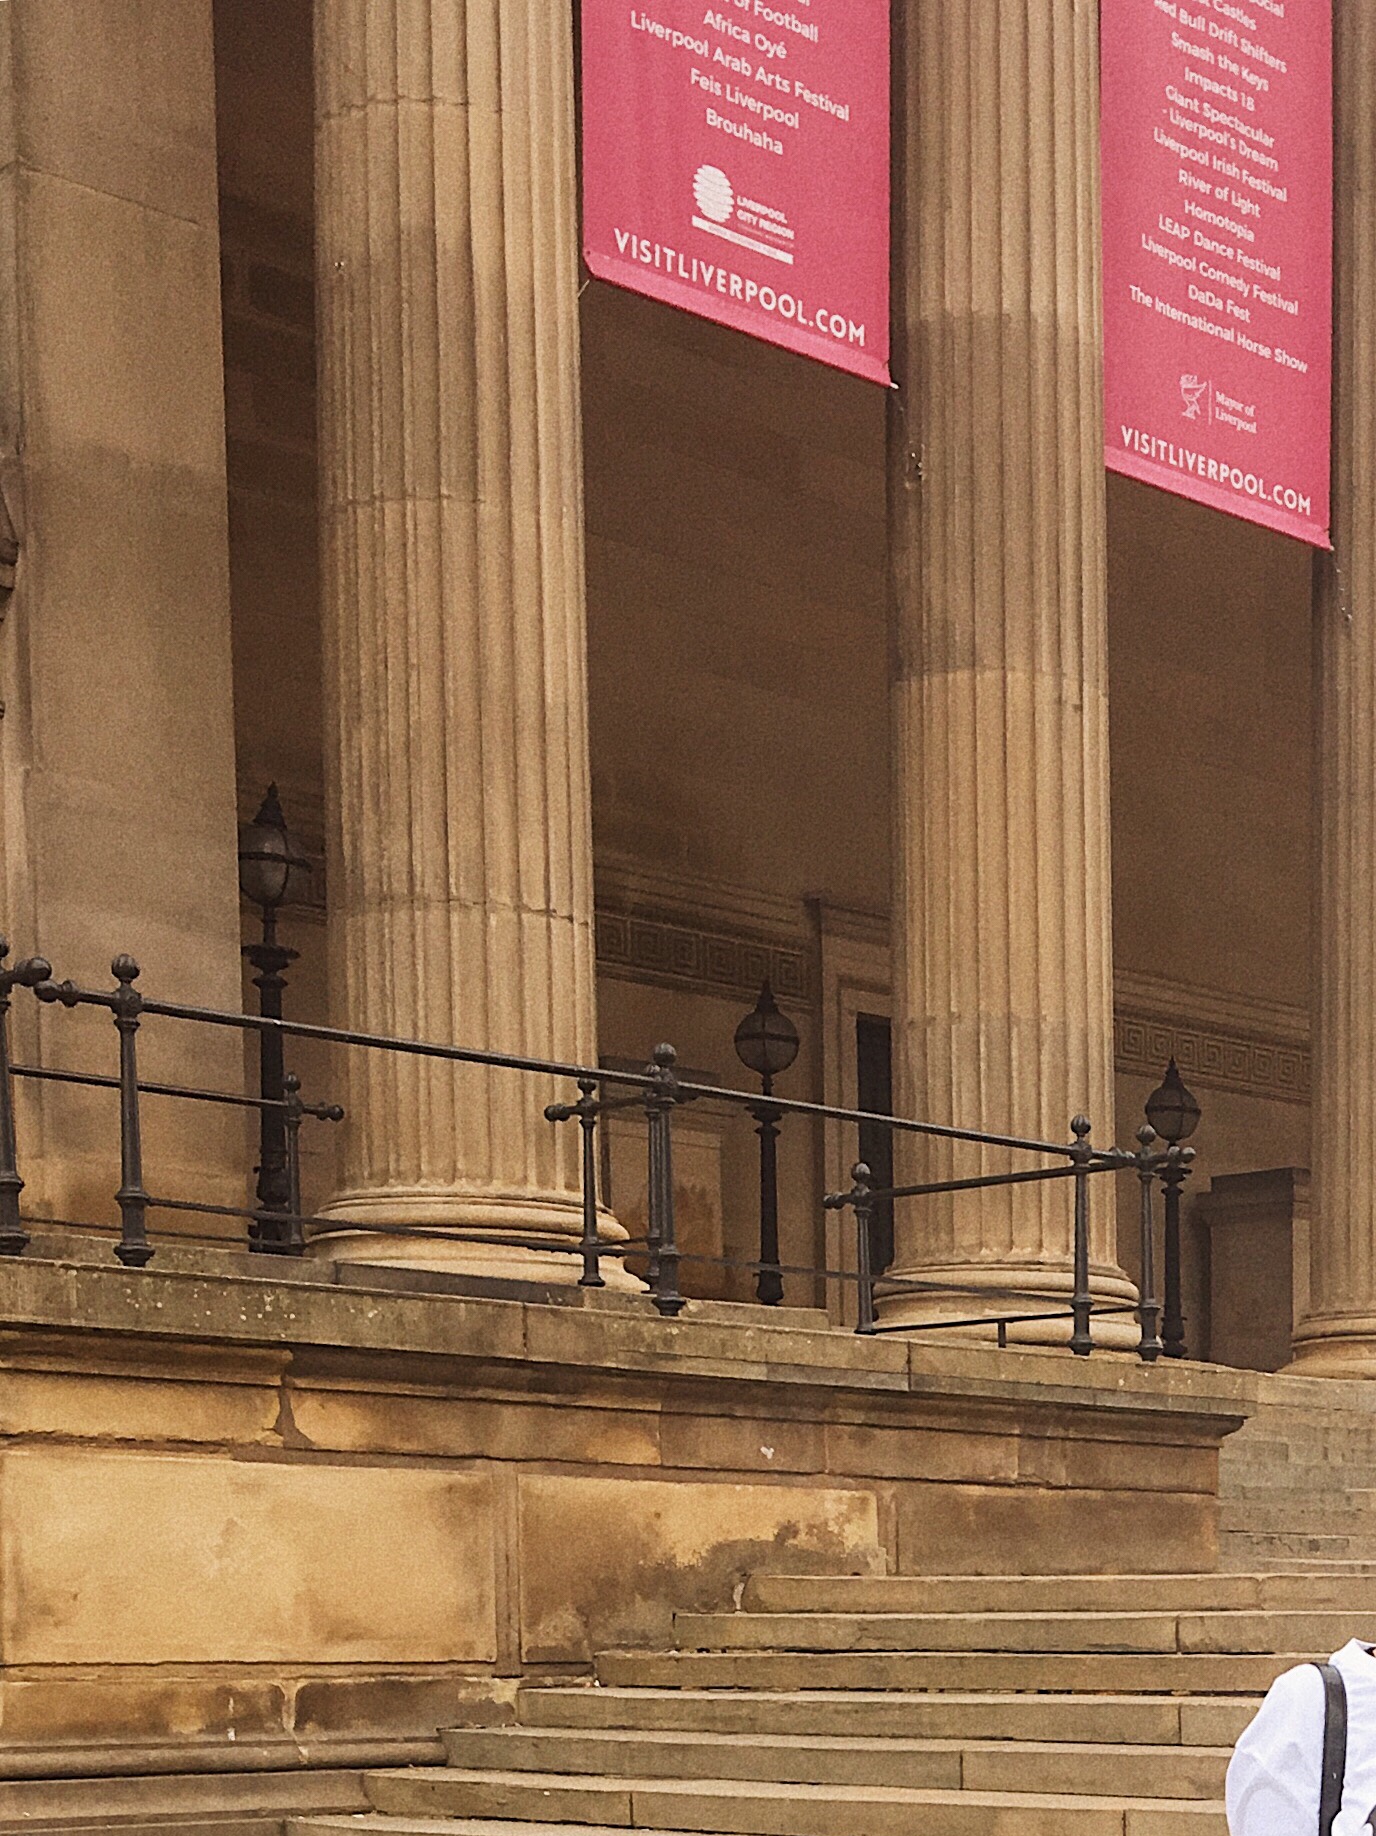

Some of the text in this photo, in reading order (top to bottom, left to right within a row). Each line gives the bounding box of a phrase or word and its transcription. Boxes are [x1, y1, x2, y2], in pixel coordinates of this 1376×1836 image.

[703, 9, 788, 59] Africa Oyé
[754, 0, 819, 43] Football
[1179, 8, 1206, 32] Bull
[1208, 21, 1239, 48] Drift
[1240, 37, 1287, 73] Shifters
[630, 10, 850, 122] Liverpool Arab Arts Festival
[1171, 31, 1269, 91] Smash the Keys
[1184, 66, 1255, 112] Impacts 18
[690, 67, 799, 129] Feis Liverpool
[1165, 84, 1275, 148] Giant Spectacular
[706, 107, 783, 155] Brouhaha
[1238, 139, 1279, 172] Dream
[1153, 126, 1287, 202] Liverpool Irish Festival
[1178, 168, 1261, 218] River of Light
[1158, 213, 1281, 282] LEAP Dance Festival
[1184, 199, 1256, 243] Homotopia
[613, 227, 866, 347] VISITLIVERPOOL.COM
[1141, 233, 1299, 316] Liverpool Comedy Festival
[1187, 283, 1251, 323] DaDa Fest
[1128, 283, 1308, 374] The International Horse Show
[1120, 424, 1312, 516] VISITLIVERPOOL.COM
